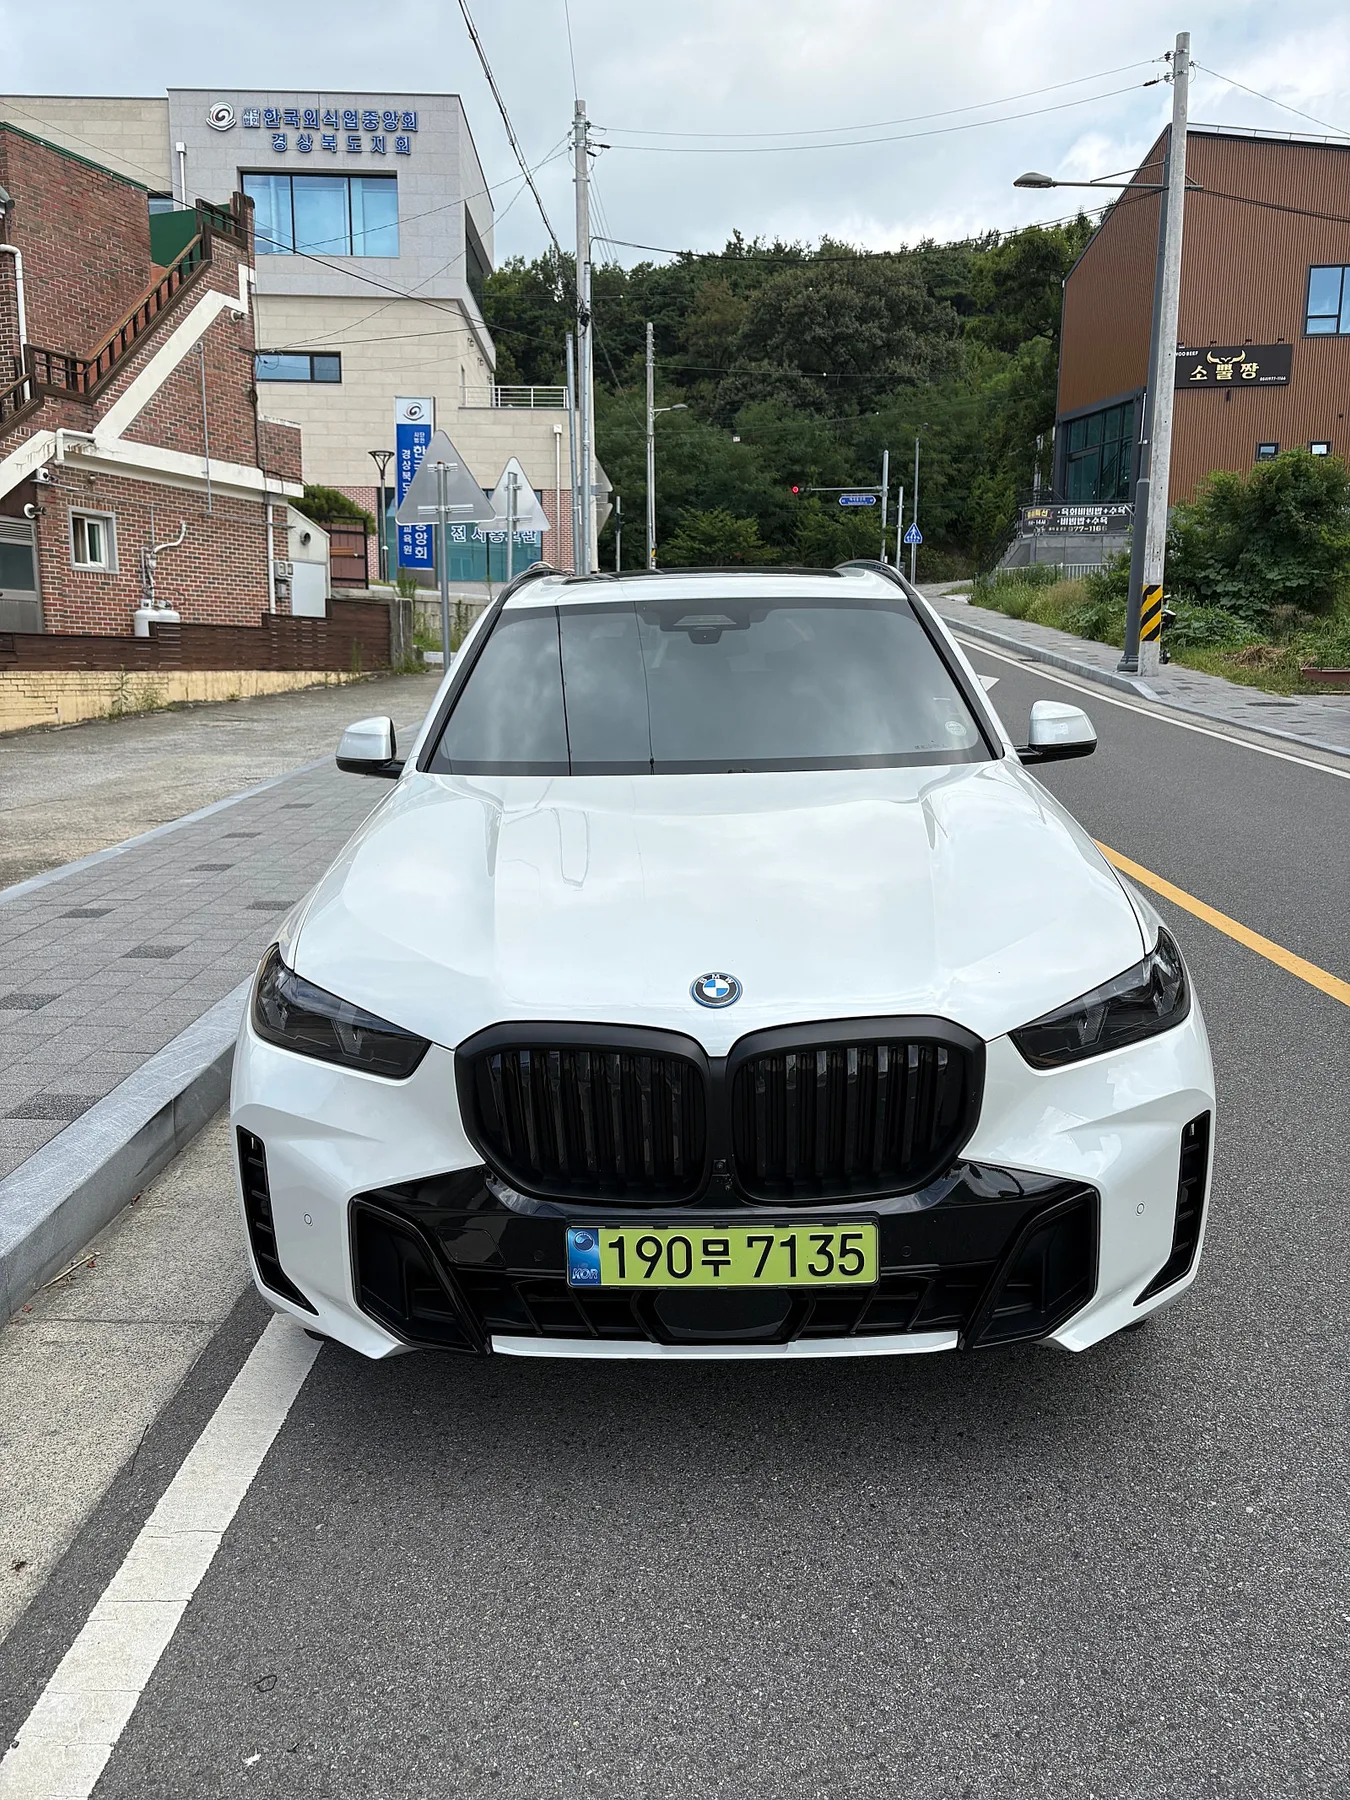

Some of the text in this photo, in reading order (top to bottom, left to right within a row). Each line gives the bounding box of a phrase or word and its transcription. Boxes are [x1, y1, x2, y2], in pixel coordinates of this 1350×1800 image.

[263, 108, 419, 132] 한국외식업중앙회
[271, 133, 412, 155] 경상북도지회
[699, 974, 733, 984] BMW
[608, 1233, 865, 1279] 190무 7135
[572, 1267, 599, 1280] KOR
